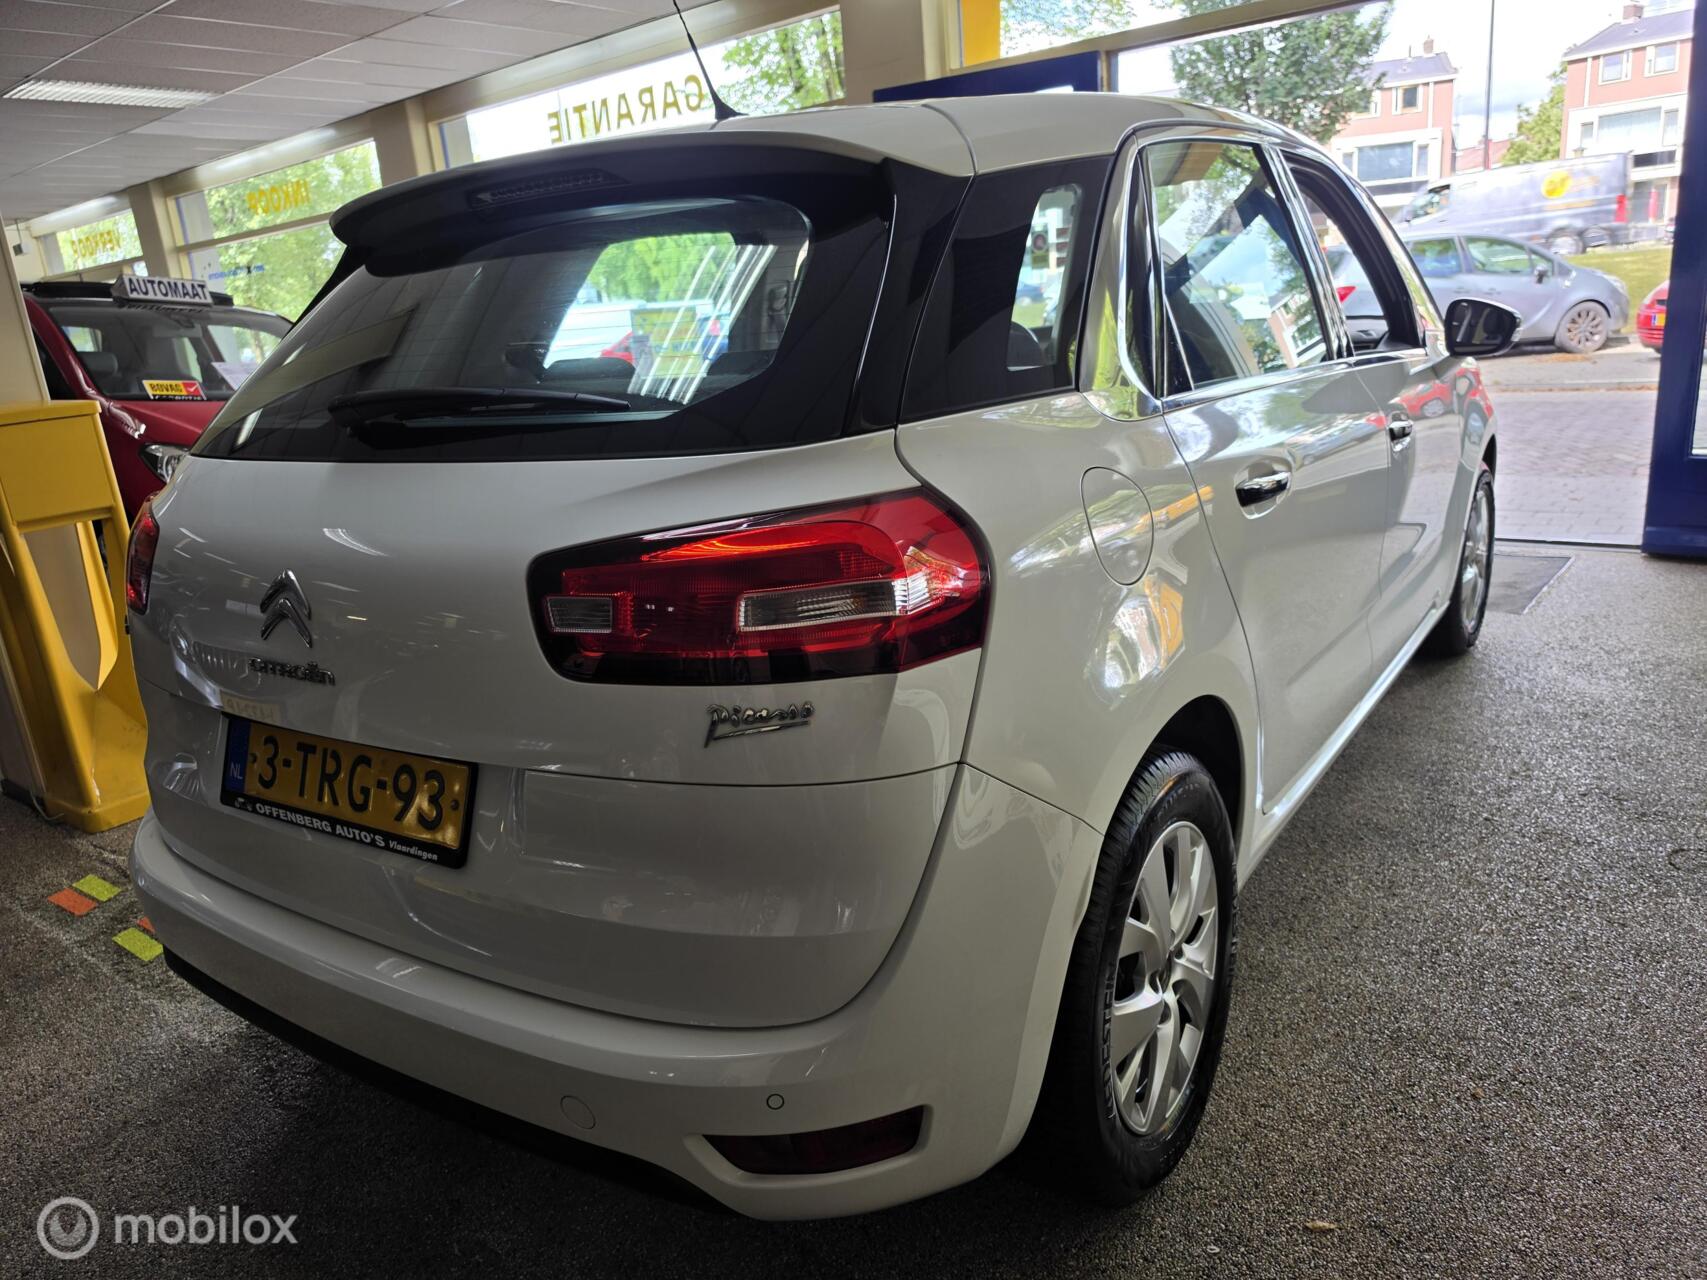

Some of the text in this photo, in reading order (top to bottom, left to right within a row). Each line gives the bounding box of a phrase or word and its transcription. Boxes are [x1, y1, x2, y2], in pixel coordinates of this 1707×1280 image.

[128, 278, 207, 300] AUTOMAAT
[230, 763, 243, 781] NL
[258, 735, 446, 831] 3-TRG-93
[255, 803, 438, 861] OFFENBERG AUTO'S Vlaardingen
